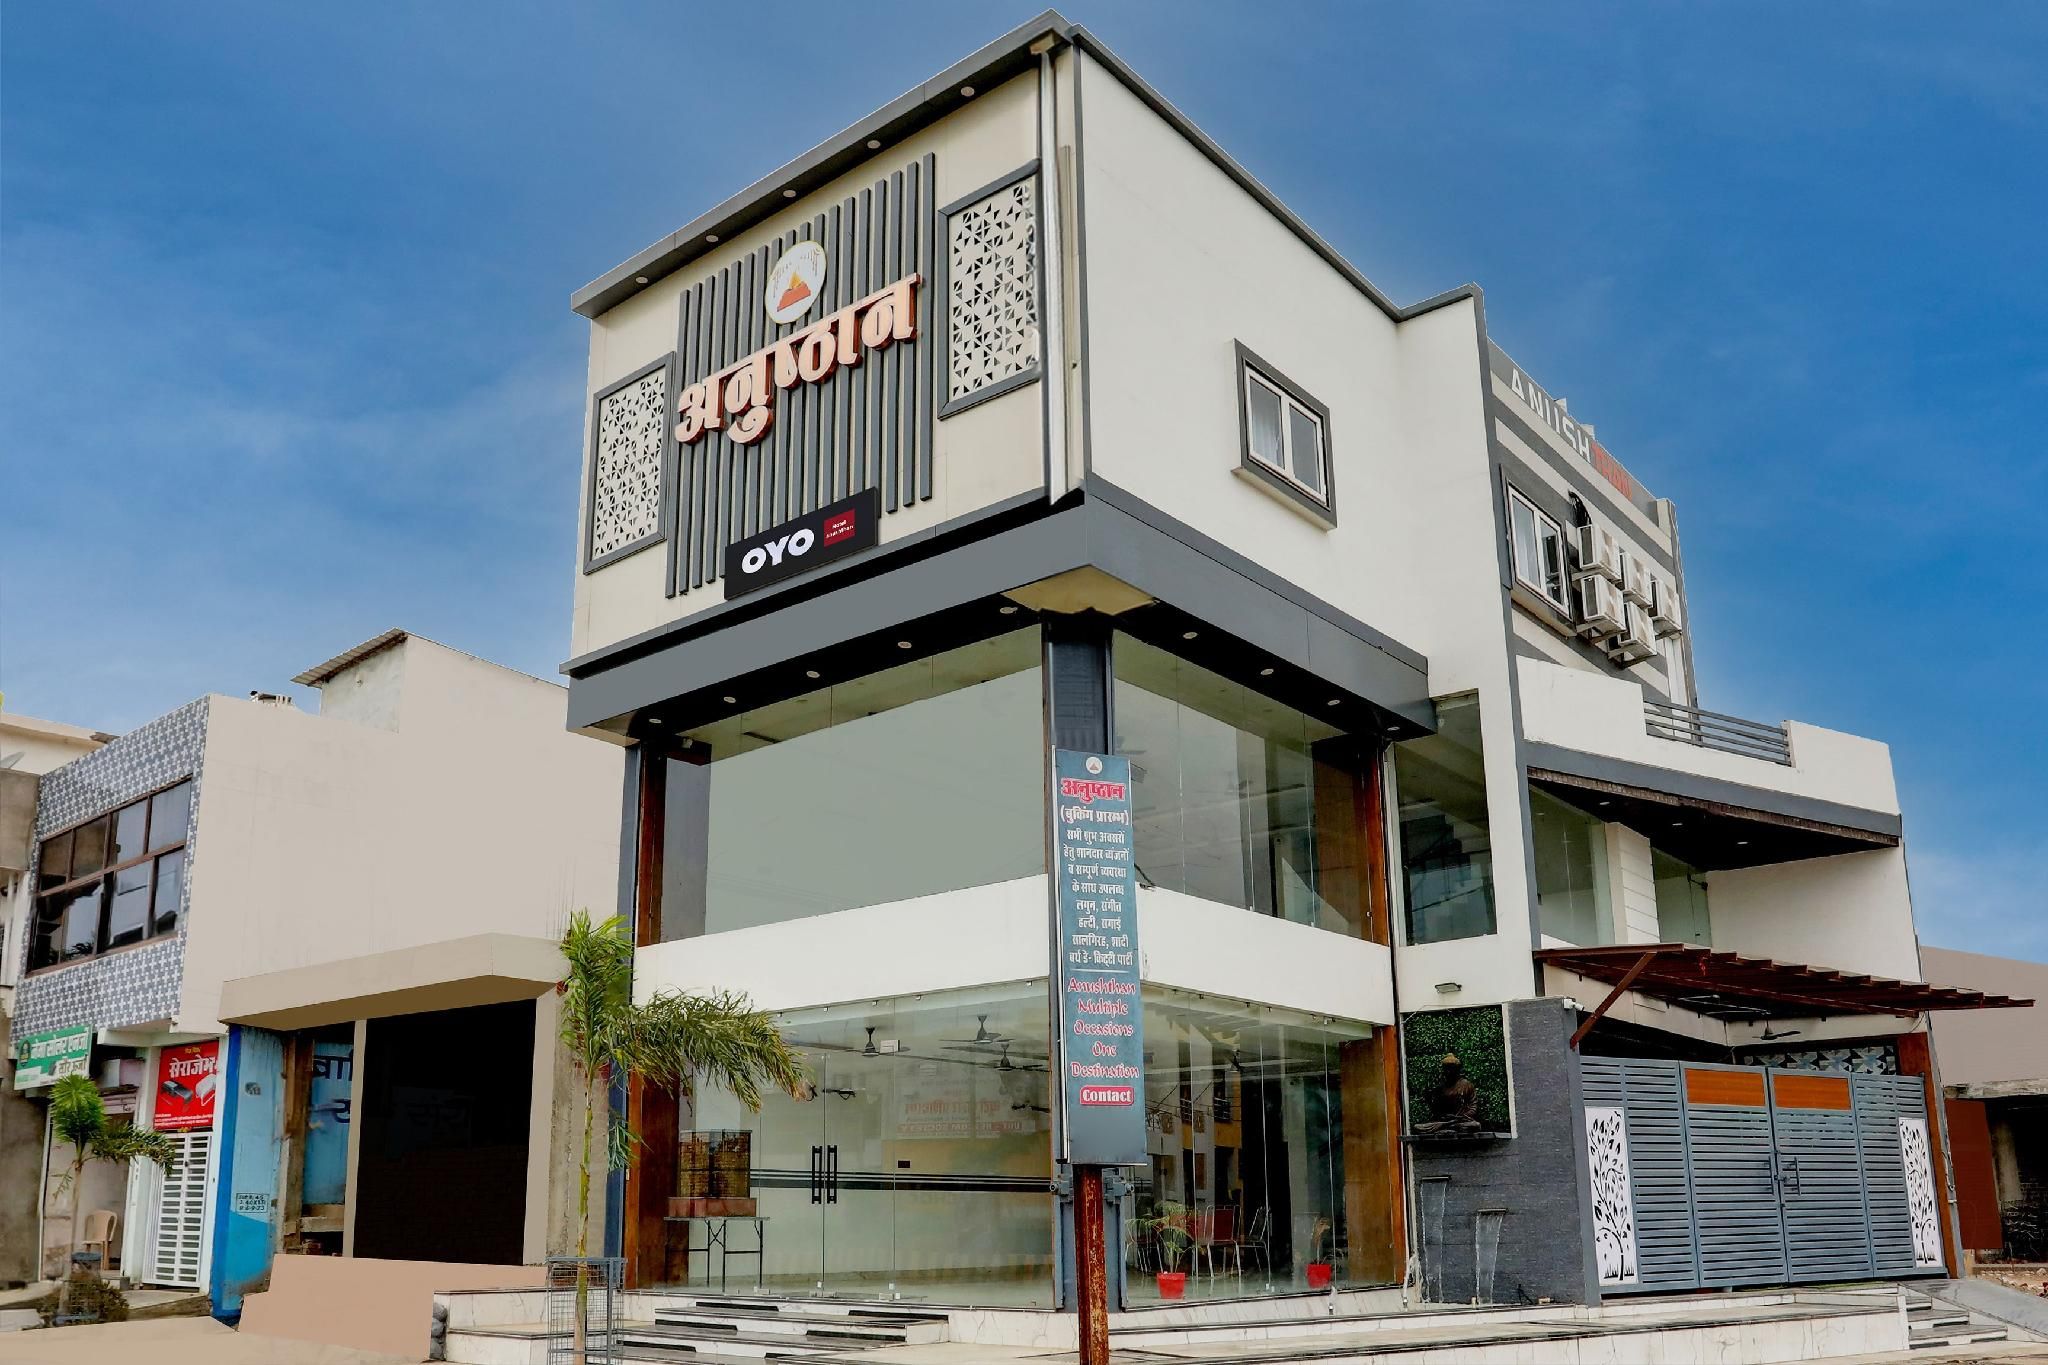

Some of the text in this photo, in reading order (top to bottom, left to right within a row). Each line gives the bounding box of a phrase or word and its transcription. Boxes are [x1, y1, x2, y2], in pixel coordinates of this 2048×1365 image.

[674, 273, 922, 446] अनुष्ठान
[741, 528, 815, 574] OYO
[1067, 977, 1136, 995] Anushthan
[1077, 999, 1128, 1018] Multiple
[1073, 1020, 1134, 1037] Occasions
[1091, 1040, 1117, 1057] One
[1071, 1061, 1140, 1079] Destination
[1082, 1089, 1131, 1103] Contact
